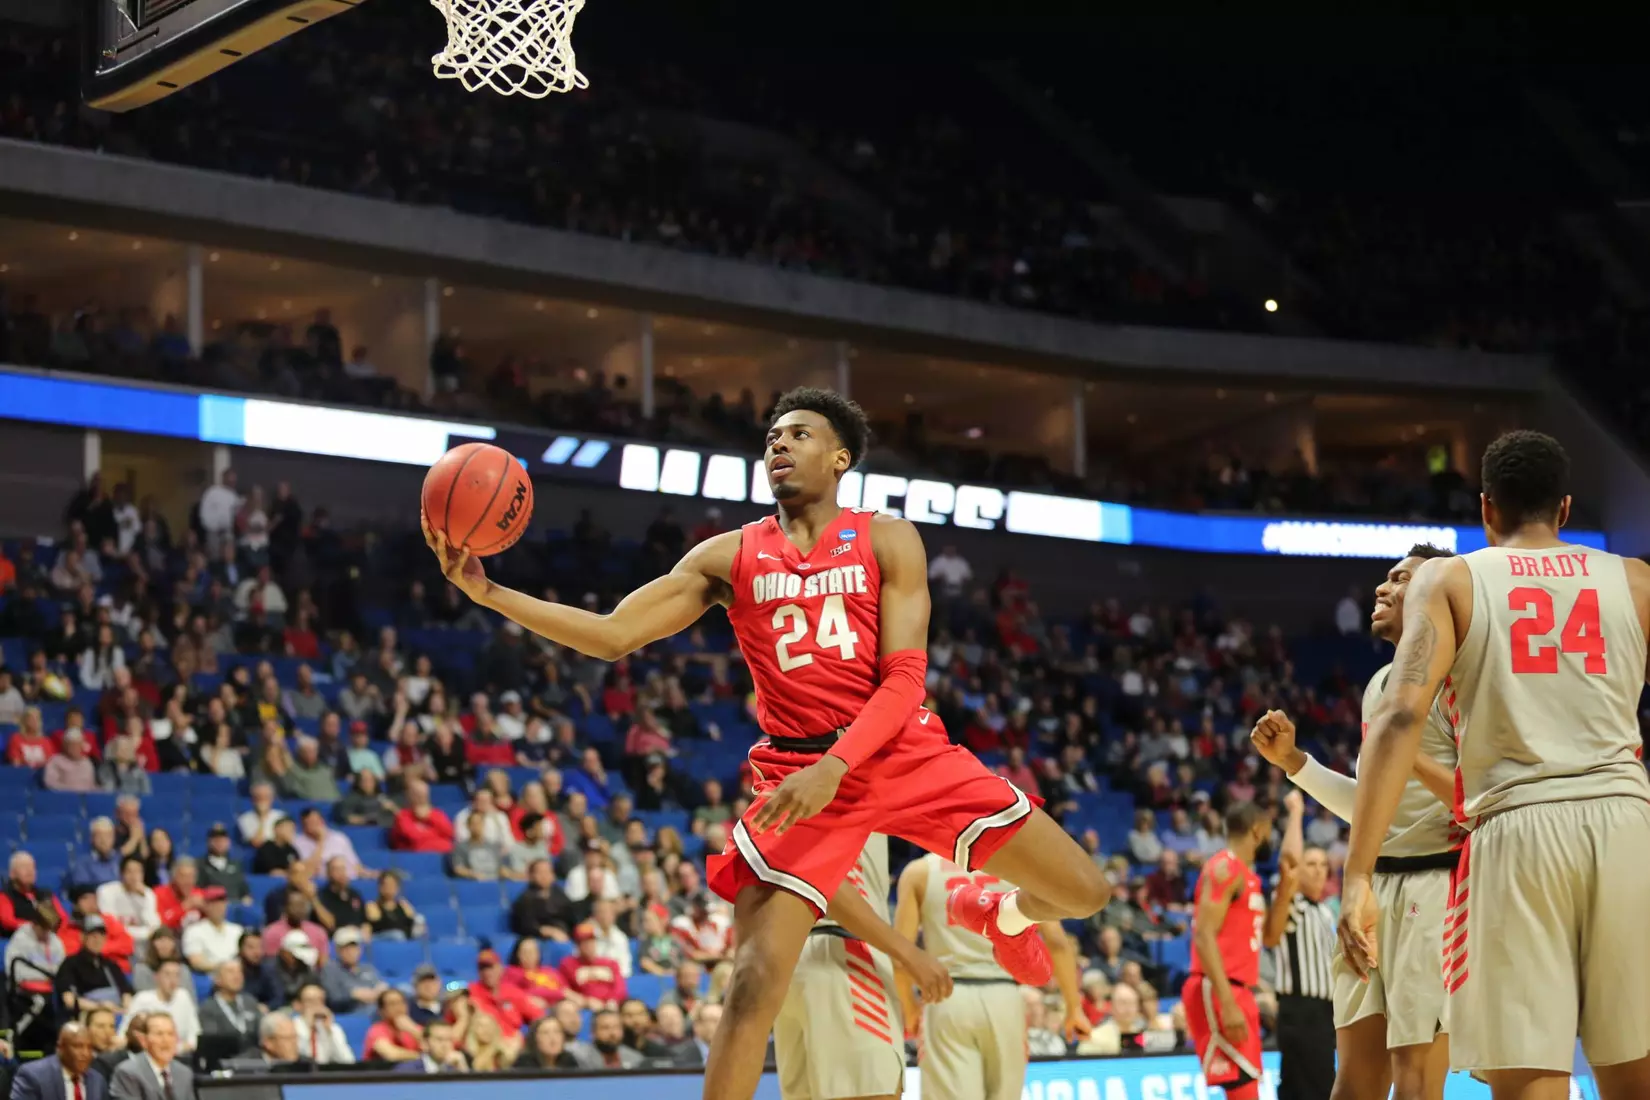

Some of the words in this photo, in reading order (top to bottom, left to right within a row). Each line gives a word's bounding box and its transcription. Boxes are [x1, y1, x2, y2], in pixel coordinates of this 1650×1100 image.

[496, 480, 526, 531] NCAA
[753, 572, 802, 604] OHIO
[804, 565, 868, 598] STATE
[1506, 553, 1589, 577] BRADY
[772, 593, 859, 673] 24
[1508, 587, 1607, 675] 24
